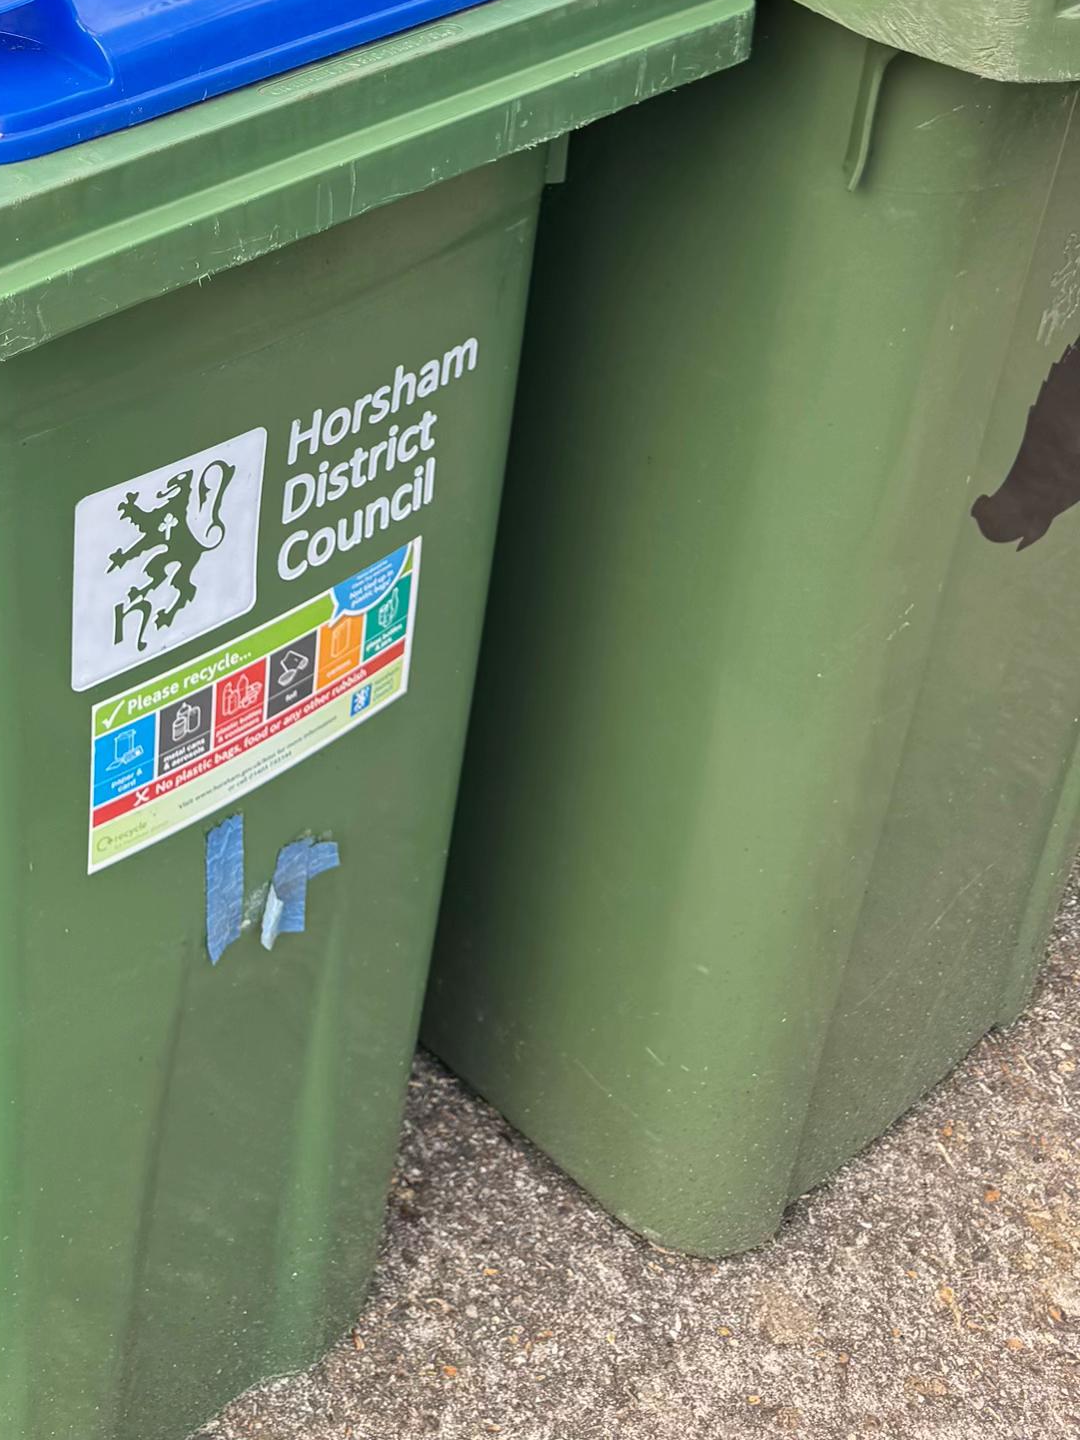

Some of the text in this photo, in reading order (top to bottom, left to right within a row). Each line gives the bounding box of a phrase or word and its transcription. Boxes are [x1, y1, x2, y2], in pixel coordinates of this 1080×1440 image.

[287, 336, 480, 465] Horsham
[281, 411, 438, 525] District
[277, 457, 434, 582] Council
[128, 651, 252, 715] Please recycle...
[155, 781, 173, 794] No
[175, 757, 212, 788] plastic
[214, 745, 242, 767] bags,
[243, 727, 269, 747] food
[269, 721, 281, 734] or
[284, 709, 302, 727] any
[303, 689, 331, 711] other
[332, 668, 367, 698] rubbish
[163, 739, 205, 764] metal cans
[171, 746, 205, 768] aerosols
[111, 773, 134, 789] paper
[118, 779, 136, 792] card
